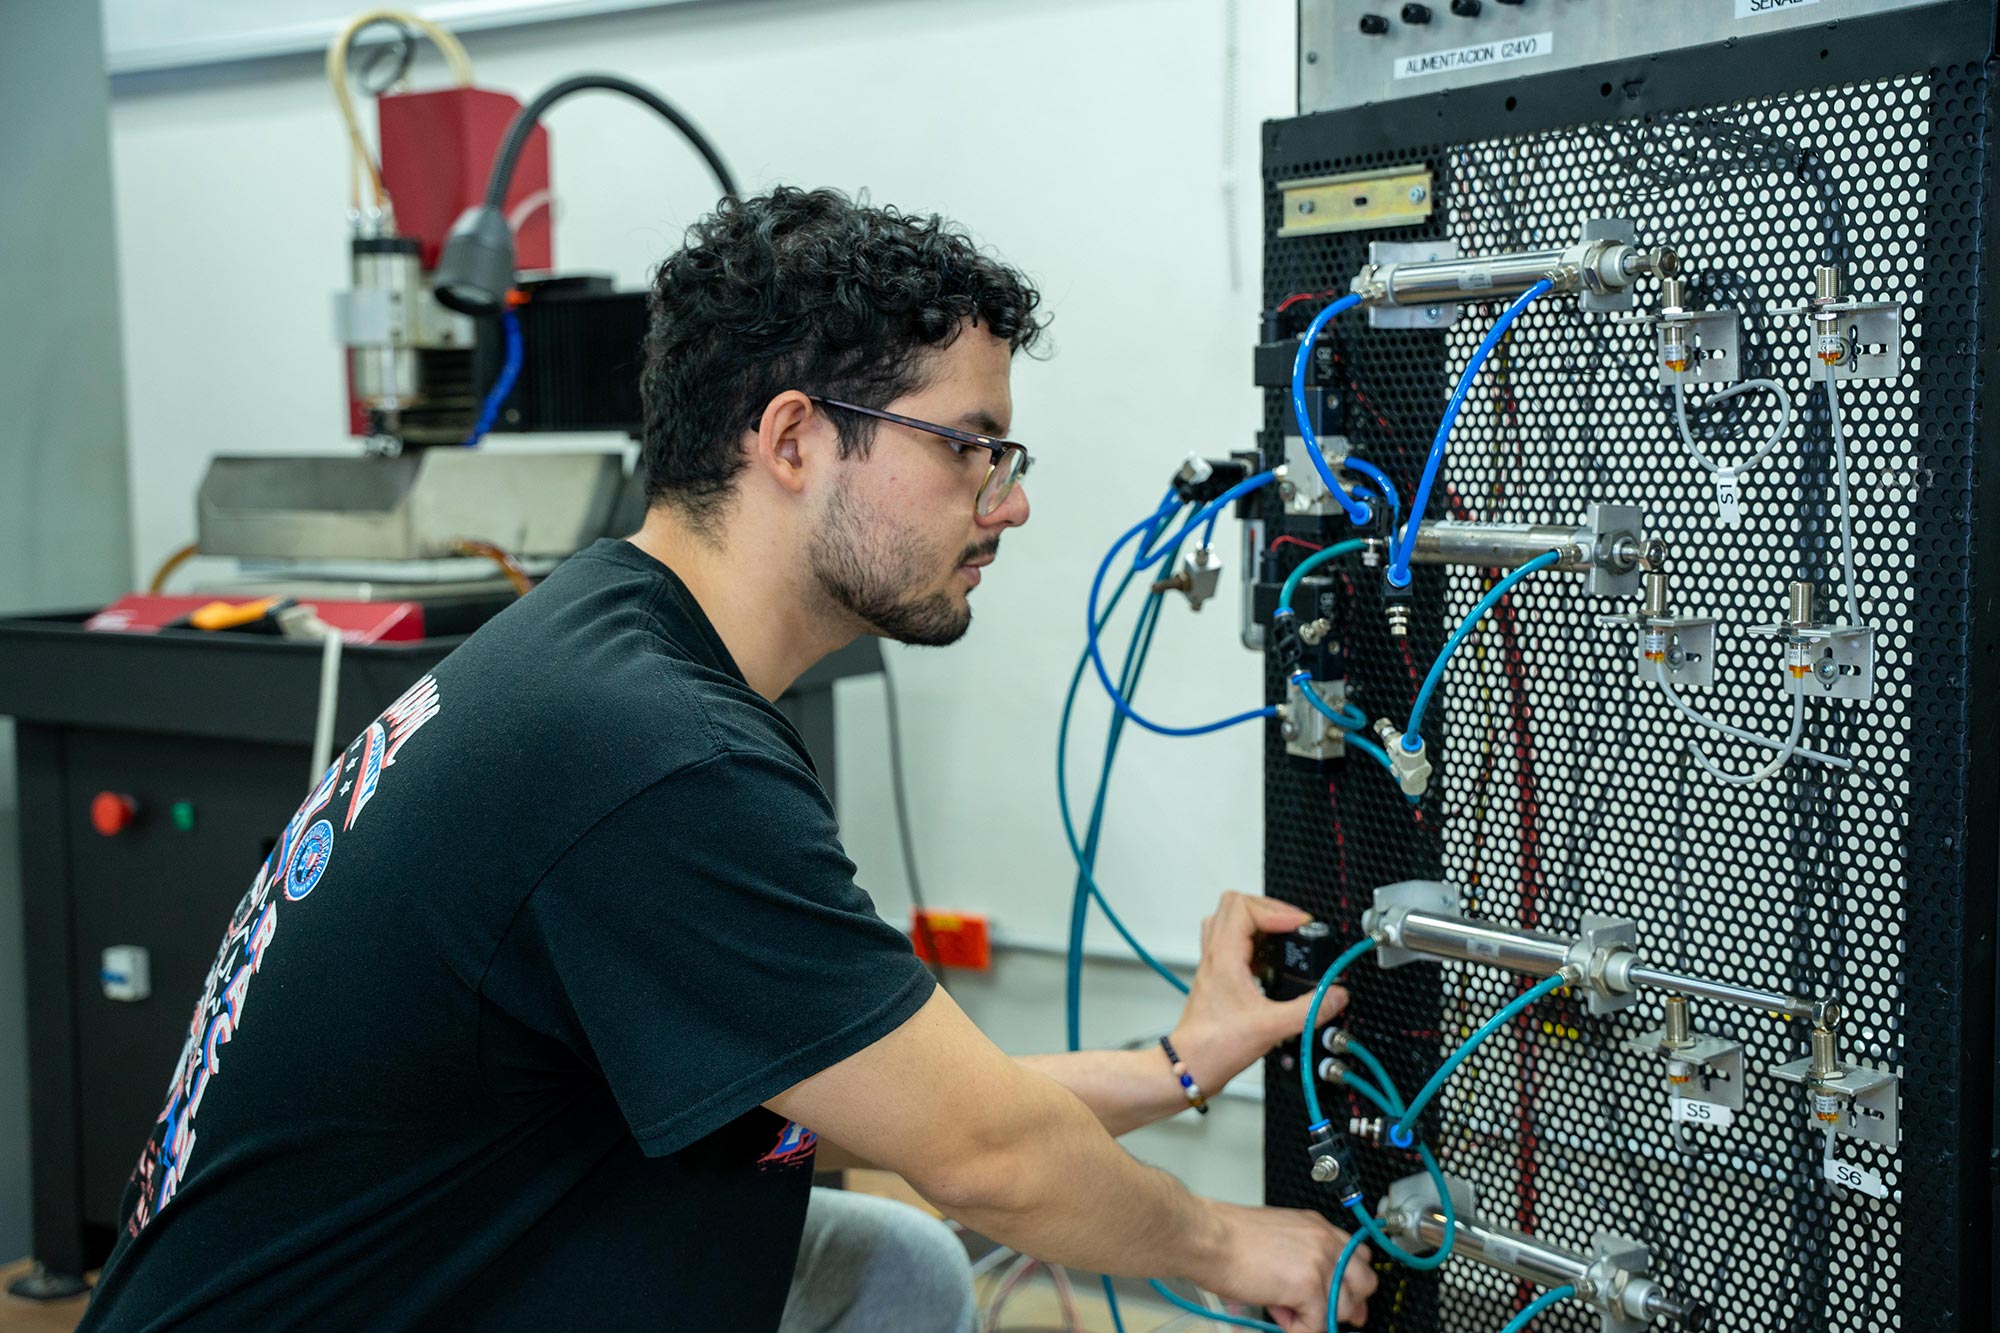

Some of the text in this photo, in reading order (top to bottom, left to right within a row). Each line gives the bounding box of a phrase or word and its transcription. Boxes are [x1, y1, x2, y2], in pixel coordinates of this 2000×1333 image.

[1751, 0, 1804, 11] SEN
[1404, 37, 1537, 73] ALIMENTACION (24V)
[1720, 484, 1734, 504] S1
[1686, 1102, 1711, 1119] S5
[1836, 1166, 1862, 1185] S6
